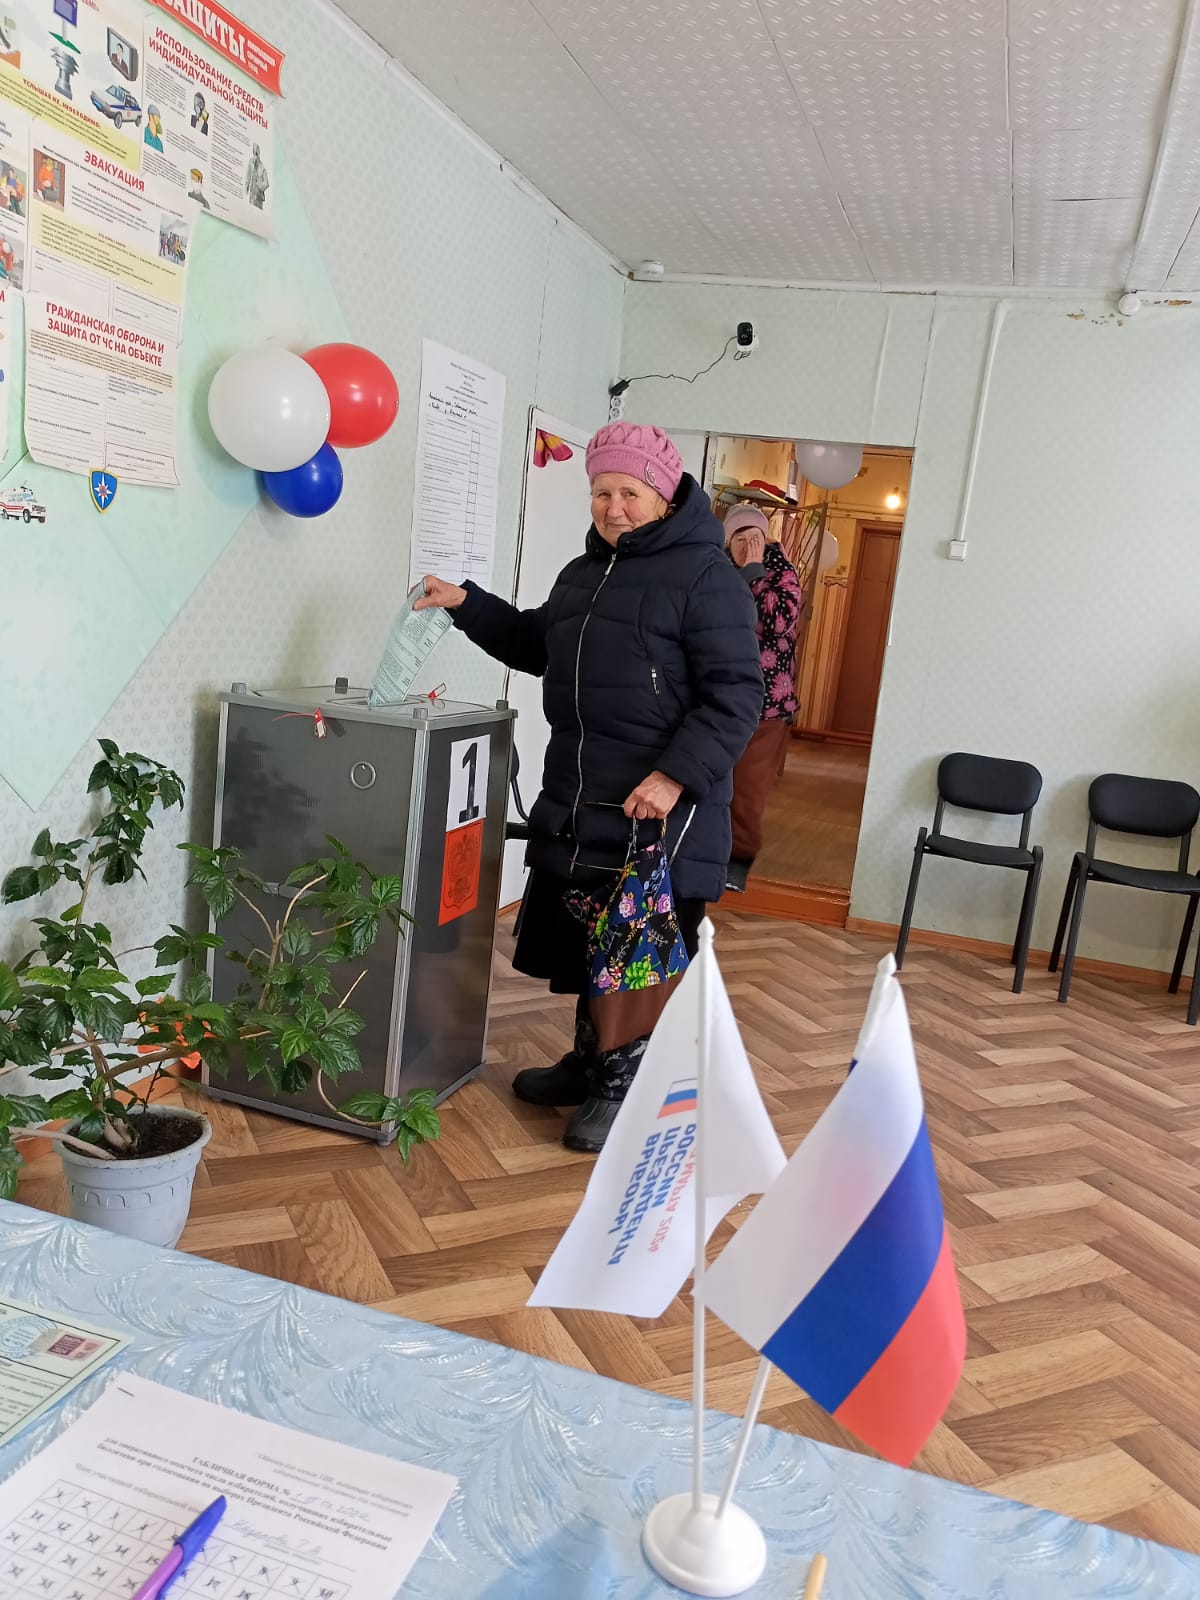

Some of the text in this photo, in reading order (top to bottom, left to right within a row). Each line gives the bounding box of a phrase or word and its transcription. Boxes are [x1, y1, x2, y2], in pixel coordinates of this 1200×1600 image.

[149, 37, 235, 105] ИНДИВИДУАЛЬНОЙ
[235, 98, 268, 129] ЗАЩИТЫ
[155, 26, 232, 89] ИСПОЛЬЗОВАНИЕ
[233, 83, 264, 113] СРЕДСТВ
[84, 150, 145, 191] ЭВАКУАЦИЯ
[46, 301, 115, 336] ГРАЖДАНСКАЯ
[116, 328, 158, 351] ОБОРОНА
[158, 343, 165, 353] И
[47, 318, 162, 367] ЗАЩИТА ОТ ЧС НА ОБЪЕКТЕ
[458, 742, 479, 824] 1
[246, 1475, 280, 1493] ФОРМА
